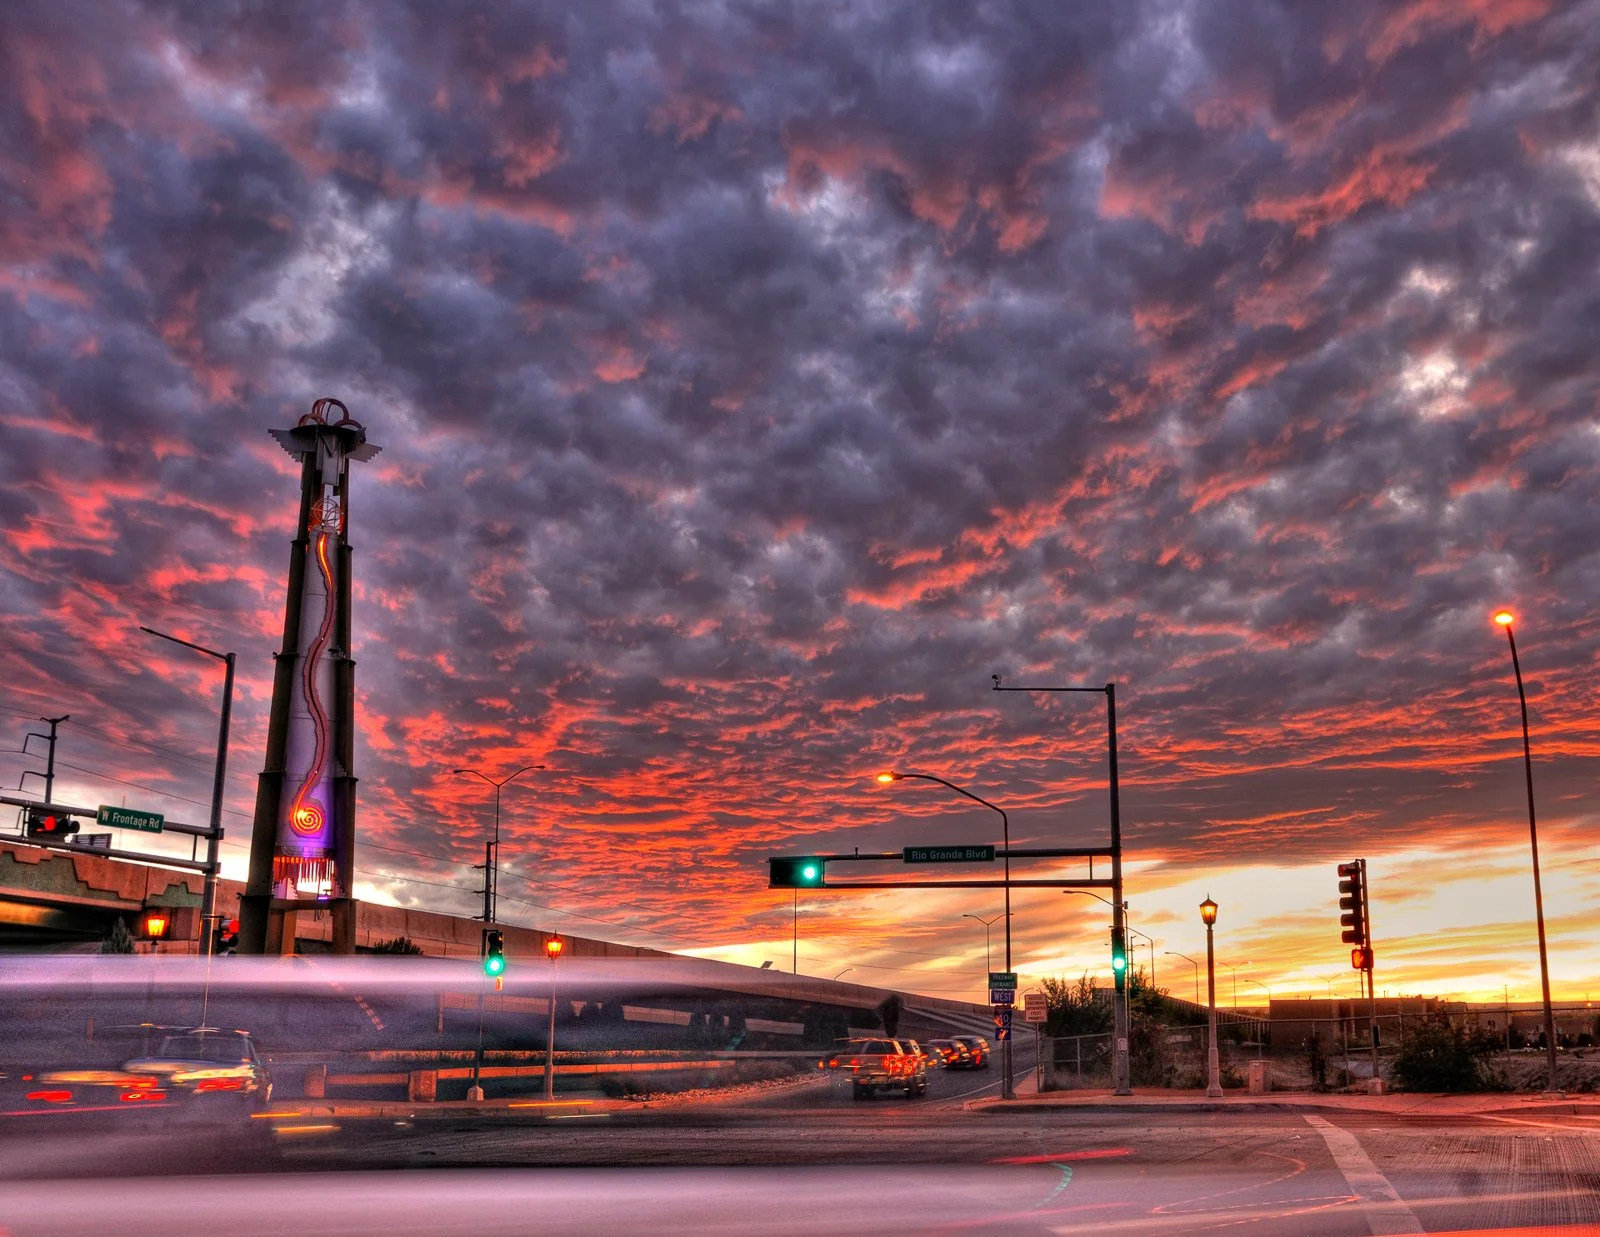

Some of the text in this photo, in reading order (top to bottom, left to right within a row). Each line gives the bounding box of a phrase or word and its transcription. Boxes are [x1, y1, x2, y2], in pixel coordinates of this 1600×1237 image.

[102, 811, 160, 829] W Frontage Rd
[911, 849, 987, 860] Rio Grande Blvd
[994, 992, 1012, 1002] WEST
